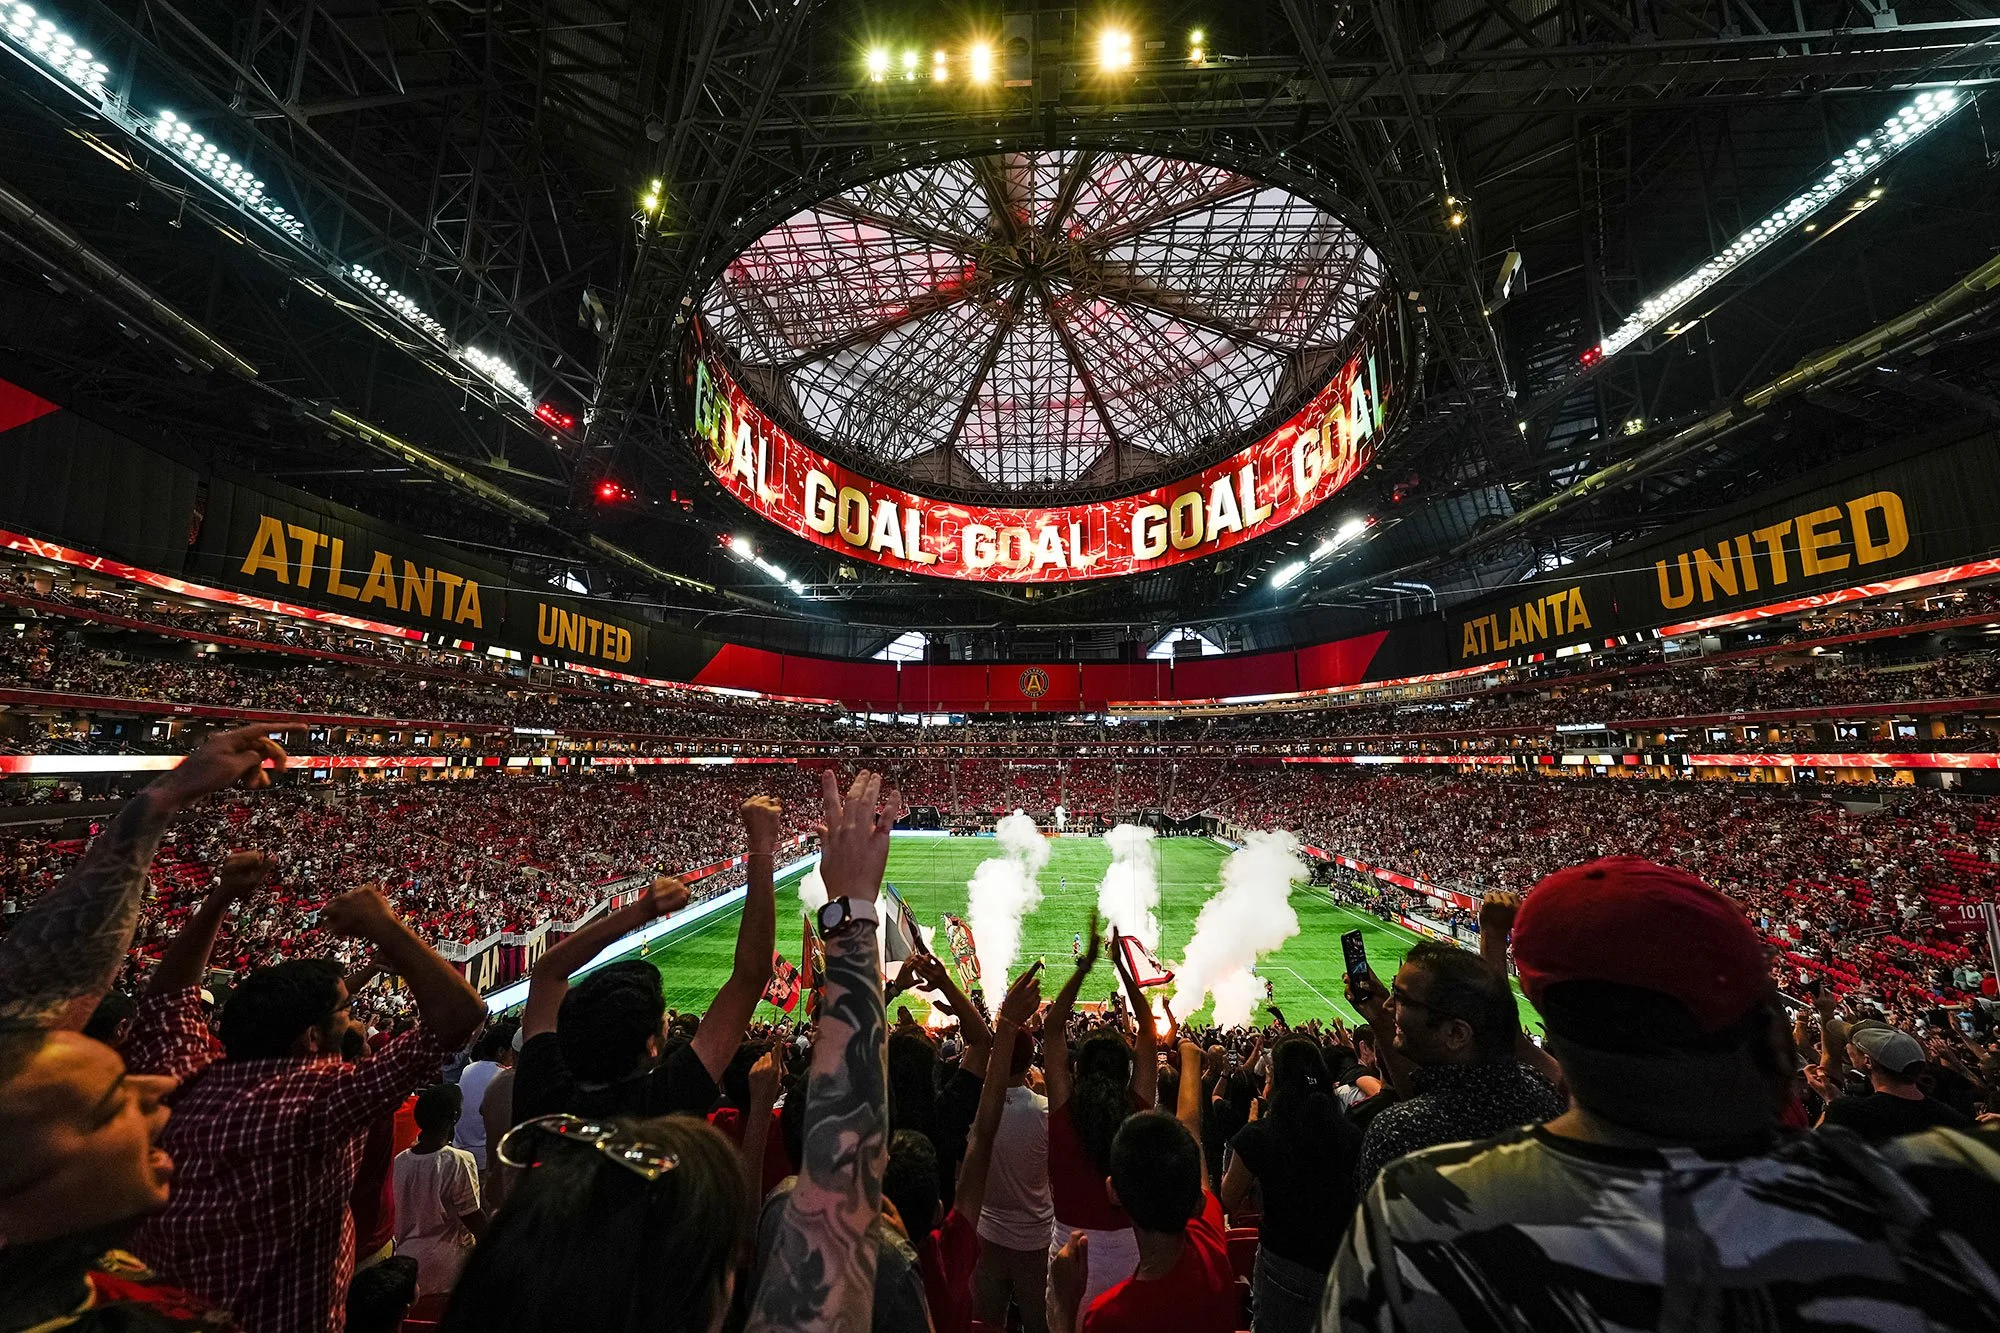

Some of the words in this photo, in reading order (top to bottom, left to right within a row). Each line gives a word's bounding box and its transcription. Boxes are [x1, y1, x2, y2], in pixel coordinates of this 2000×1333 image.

[695, 359, 784, 503] GOAL
[1292, 354, 1387, 497] GOAL
[804, 468, 938, 564] GOAL
[962, 523, 1097, 570] GOAL
[1132, 463, 1273, 561] GOAL
[1655, 490, 1910, 609] UNITED
[240, 514, 483, 629] ATLANTA
[537, 603, 632, 663] UNITED
[1461, 586, 1592, 659] ATLANTA
[1957, 904, 1985, 919] 101
